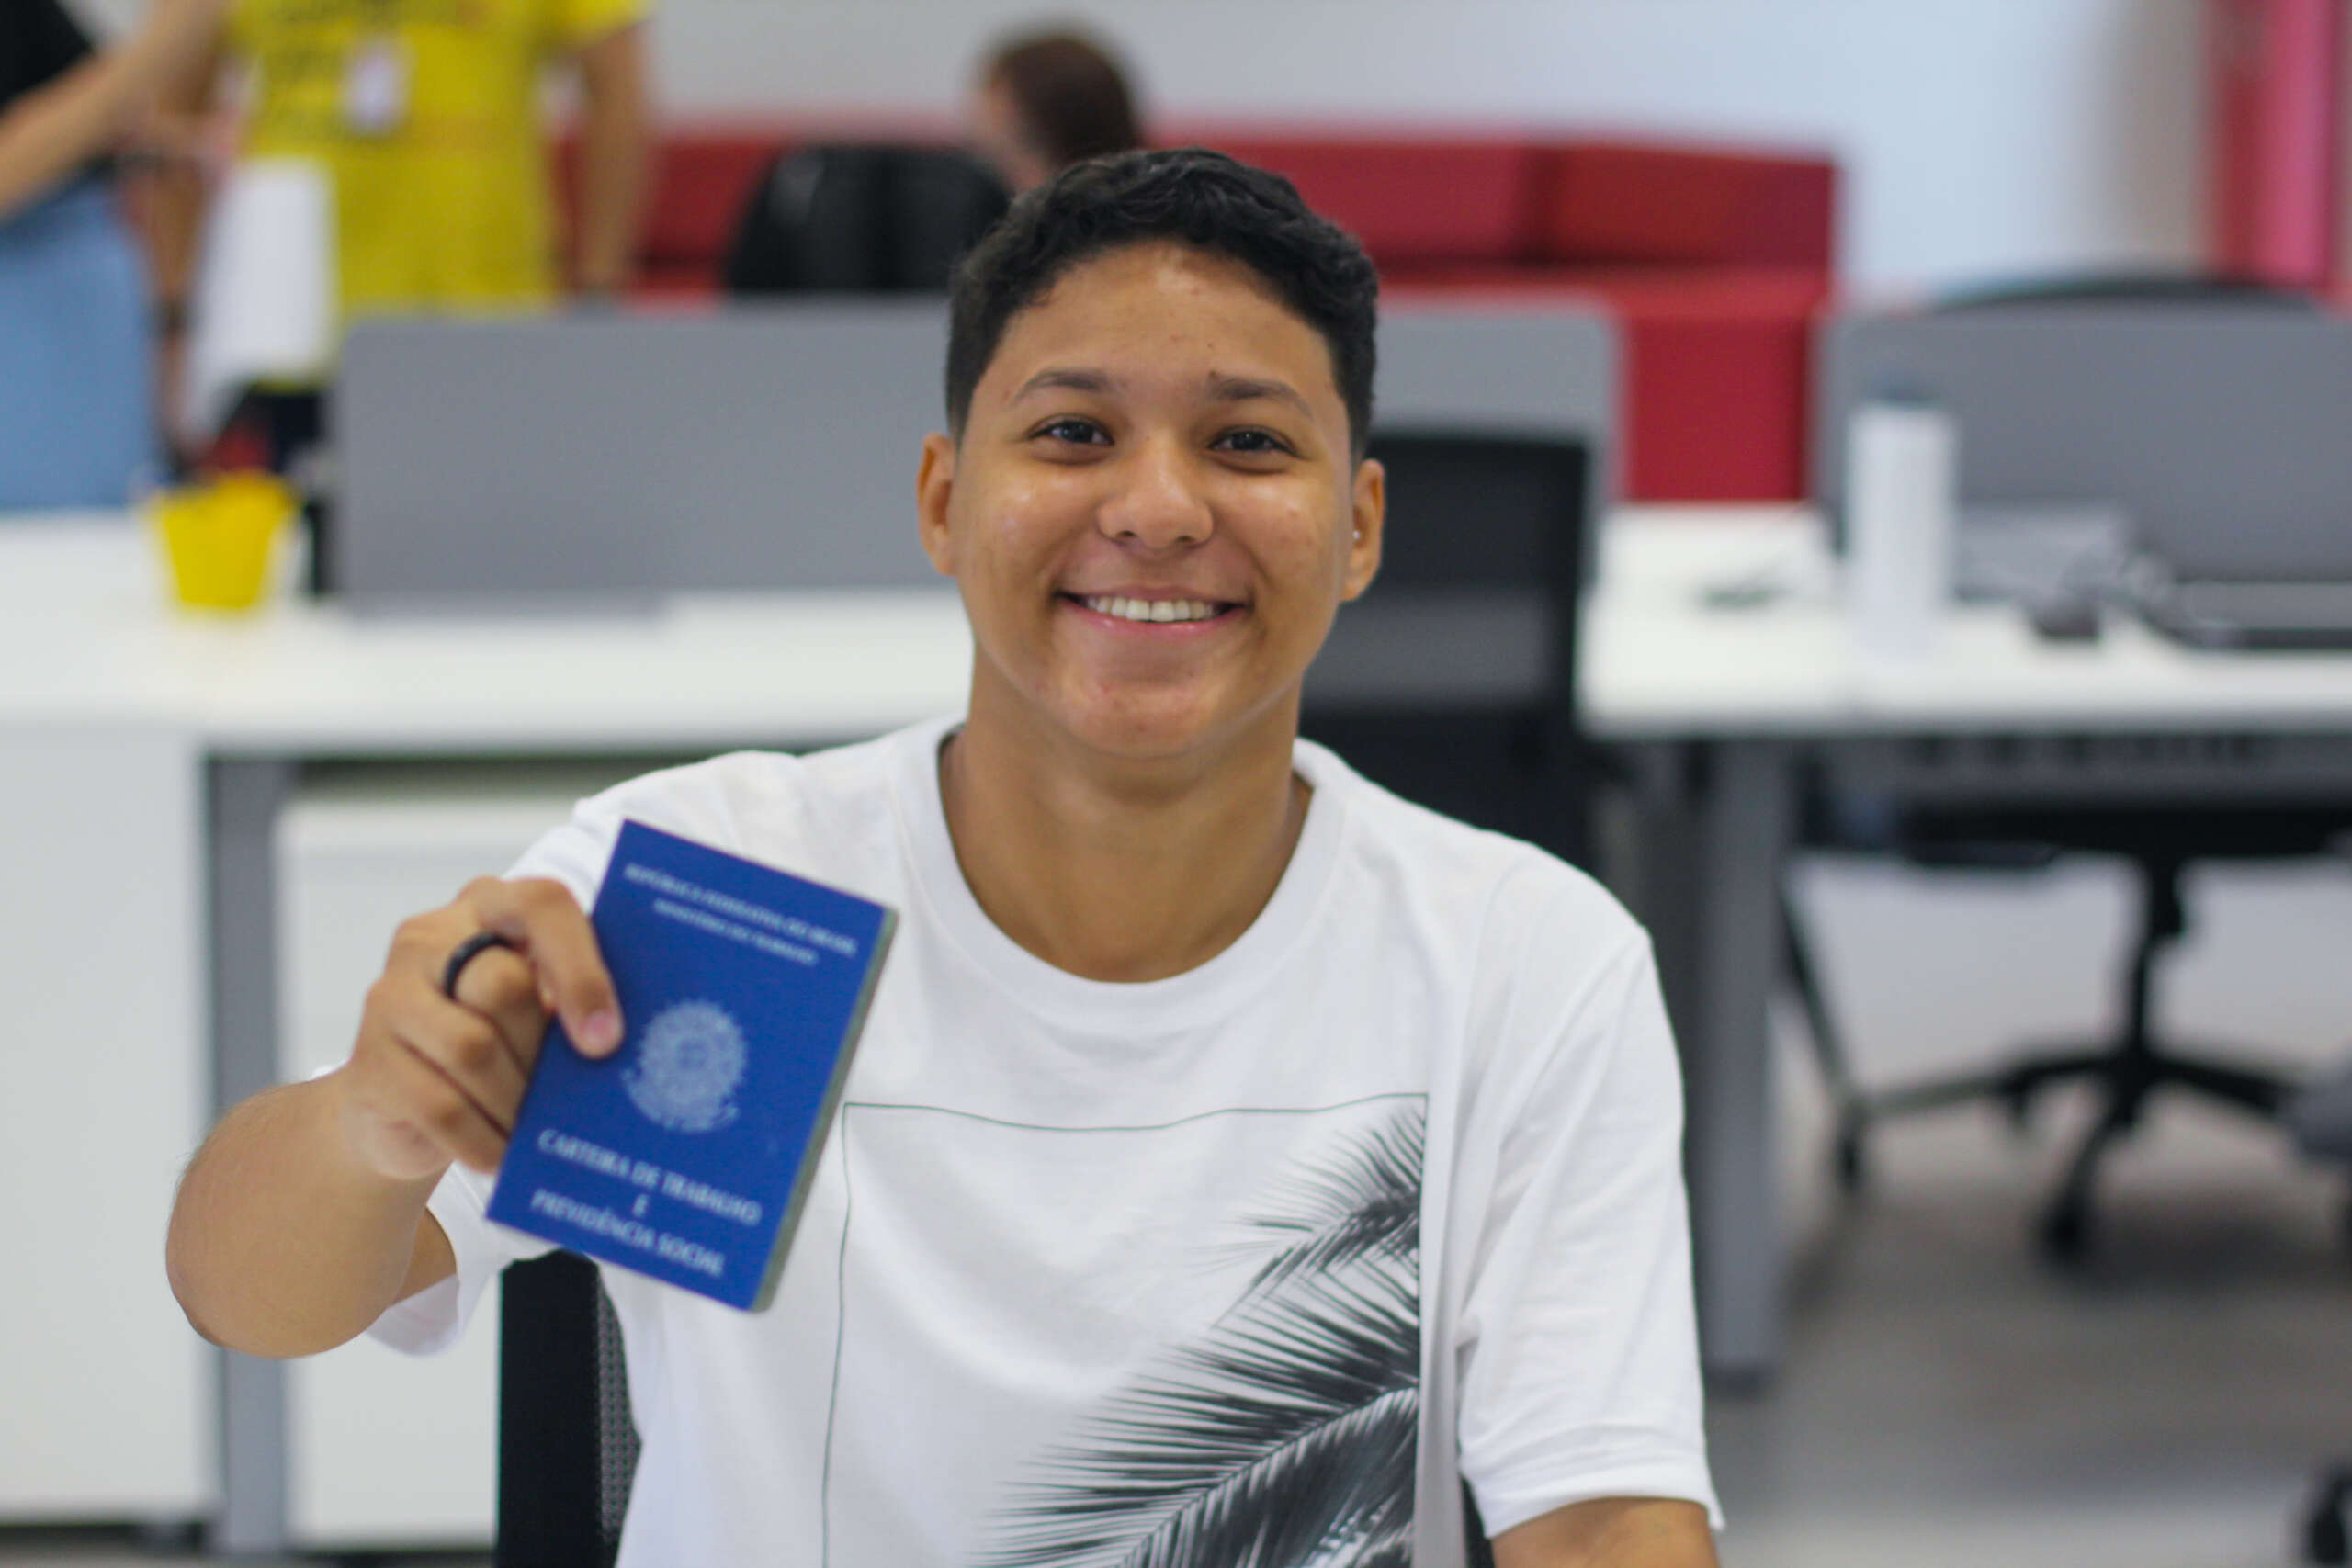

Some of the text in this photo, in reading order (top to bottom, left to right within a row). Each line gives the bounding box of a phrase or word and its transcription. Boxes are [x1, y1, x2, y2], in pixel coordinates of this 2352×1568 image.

[537, 1129, 763, 1225] CARTEIRA DE TRABALHO
[632, 1193, 649, 1217] E
[530, 1189, 725, 1277] PREVIDÊNCIA SOCIAL
